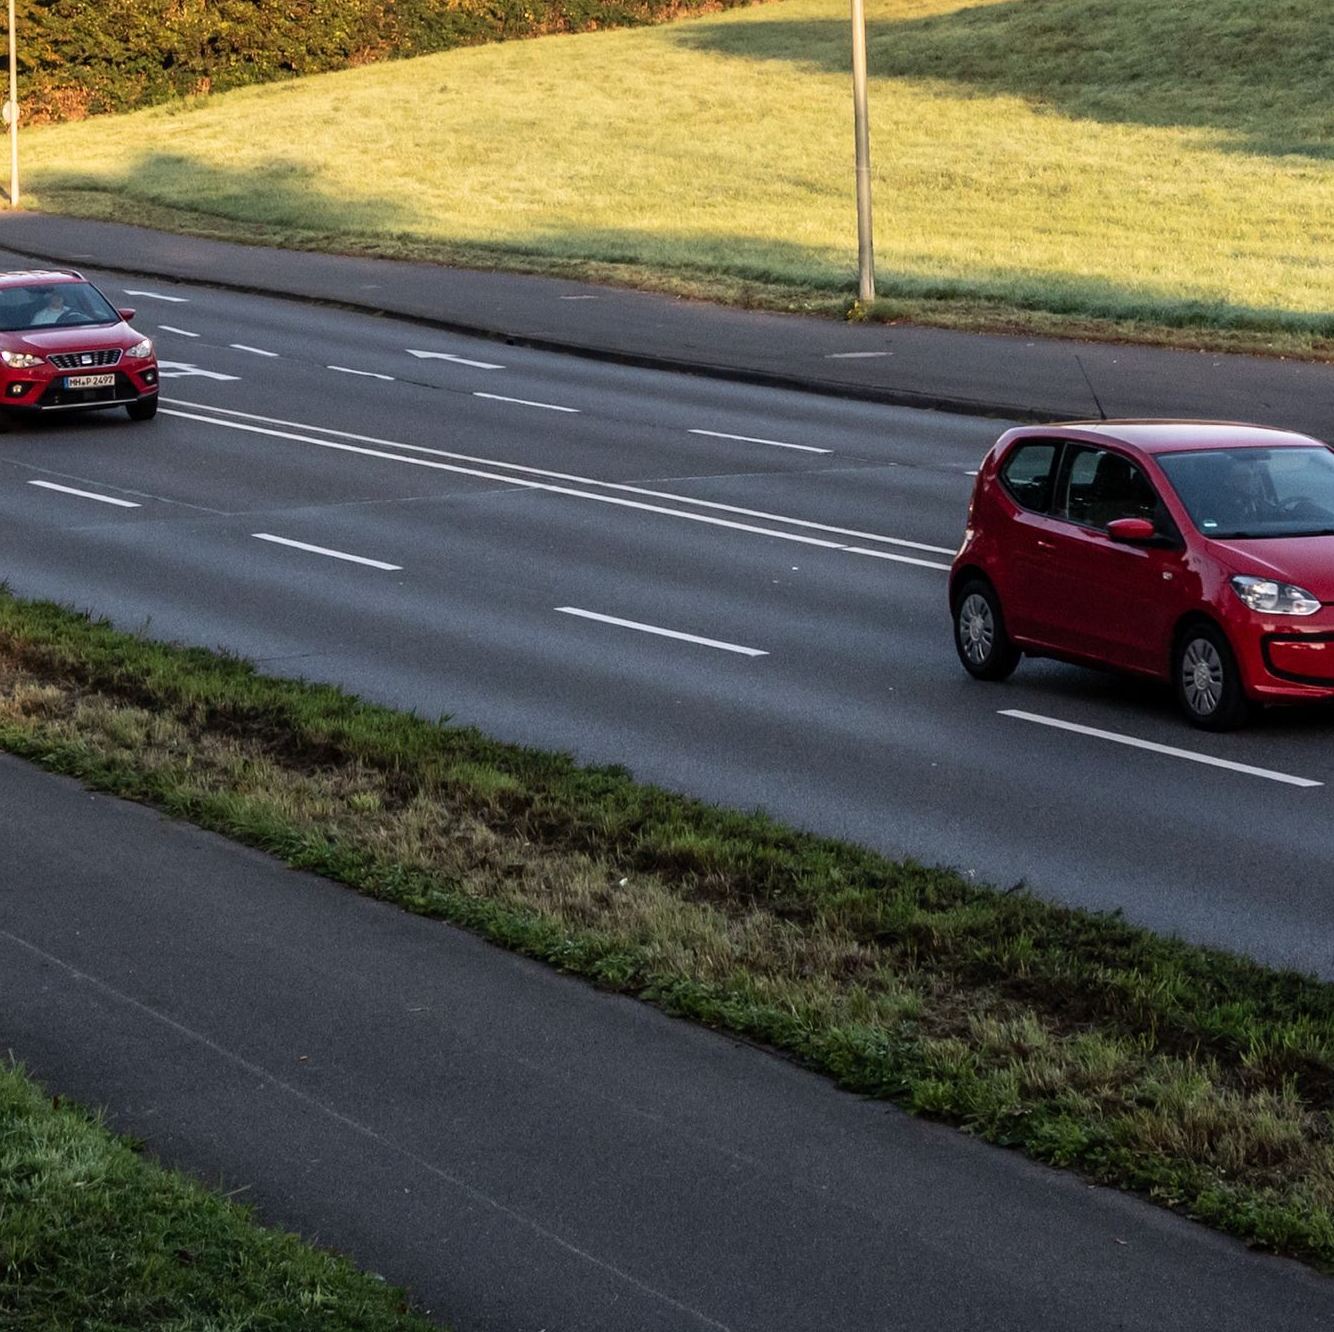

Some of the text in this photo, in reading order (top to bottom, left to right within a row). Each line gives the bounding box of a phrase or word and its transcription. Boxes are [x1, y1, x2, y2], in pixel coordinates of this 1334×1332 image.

[69, 375, 114, 386] MH P 2497
